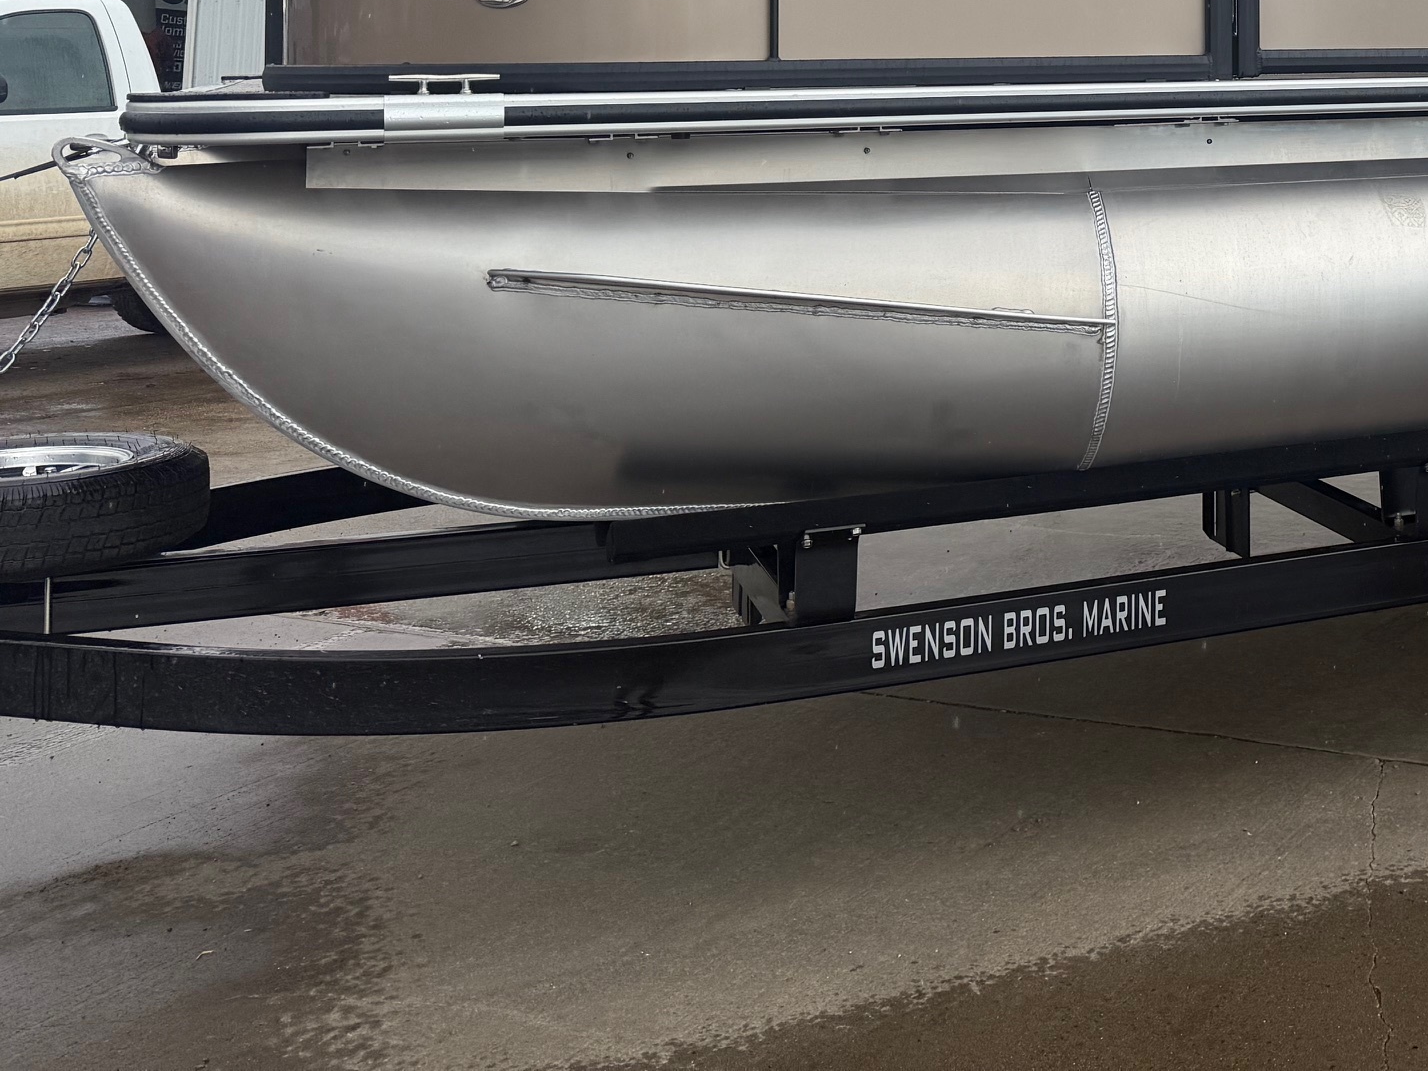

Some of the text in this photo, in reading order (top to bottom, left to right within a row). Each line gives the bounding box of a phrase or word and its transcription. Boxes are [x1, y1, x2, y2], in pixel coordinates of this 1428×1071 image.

[871, 589, 1167, 669] SWENSON BROS. MARINE
